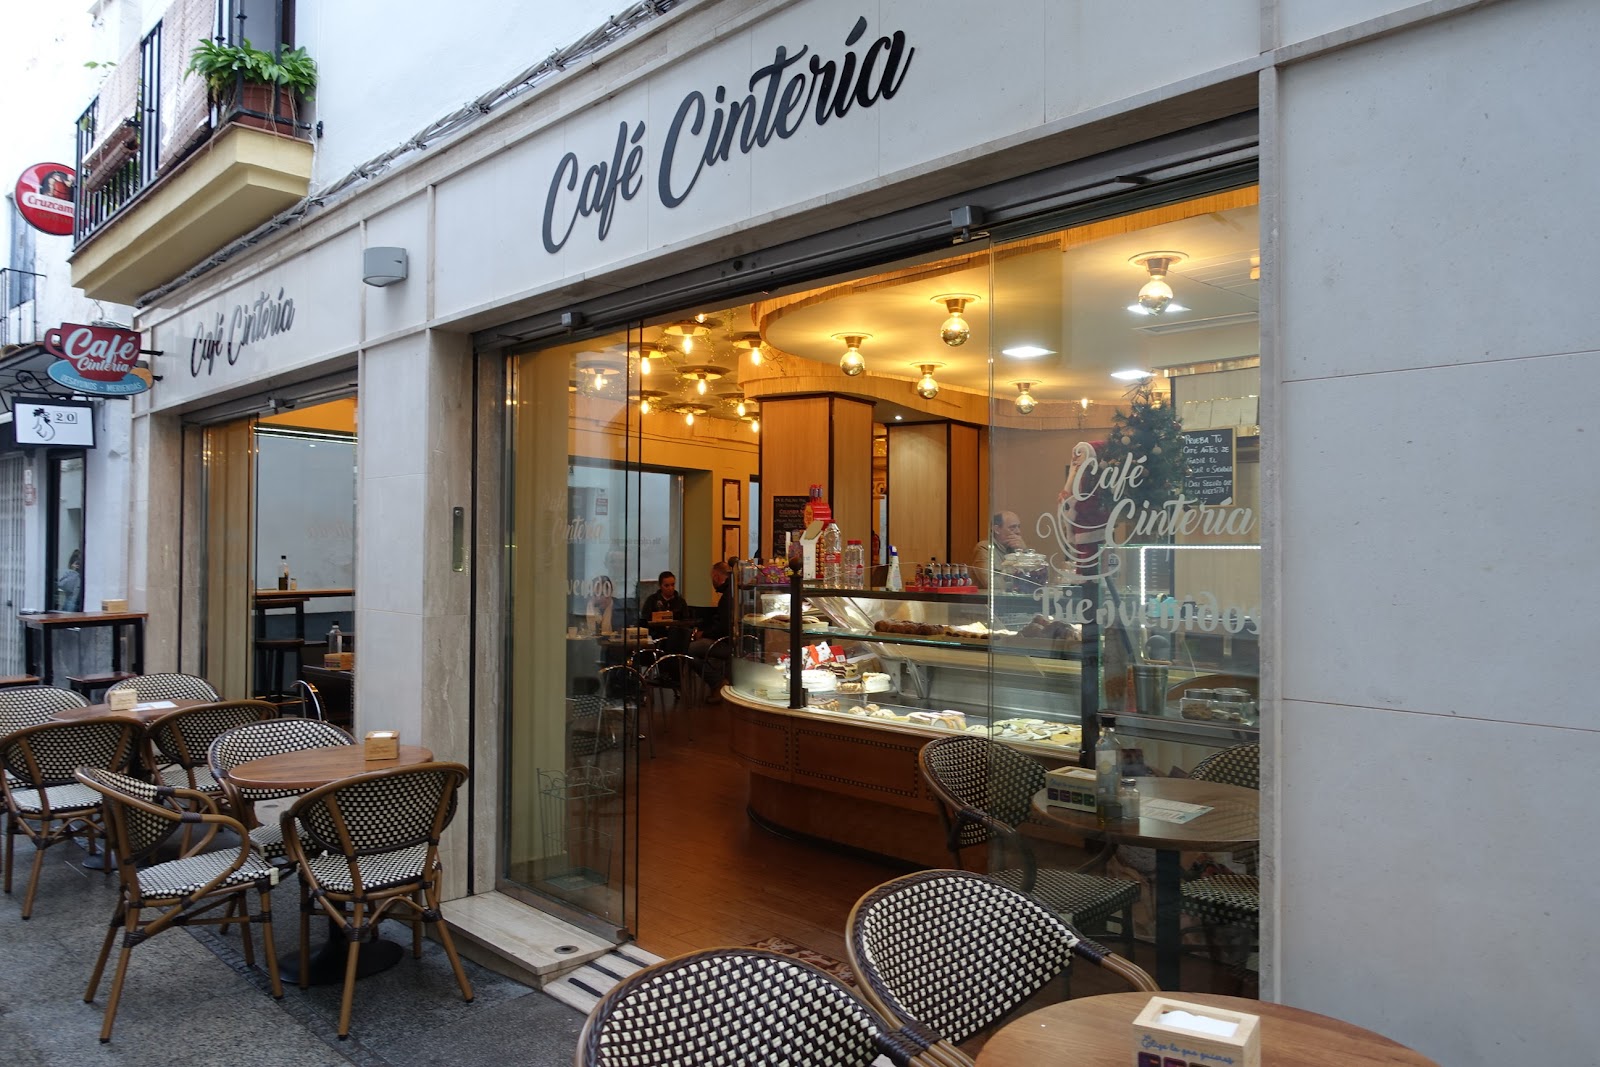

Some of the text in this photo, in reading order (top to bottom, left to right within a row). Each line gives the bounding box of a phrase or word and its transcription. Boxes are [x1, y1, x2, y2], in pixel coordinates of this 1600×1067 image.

[542, 16, 915, 253] Café Cintería
[28, 195, 74, 213] Cruzcam
[64, 327, 139, 364] Café
[191, 287, 295, 378] Café Cintería
[1072, 452, 1148, 502] Café
[1105, 493, 1257, 546] Cintería
[1033, 586, 1261, 635] Bienvenidos
